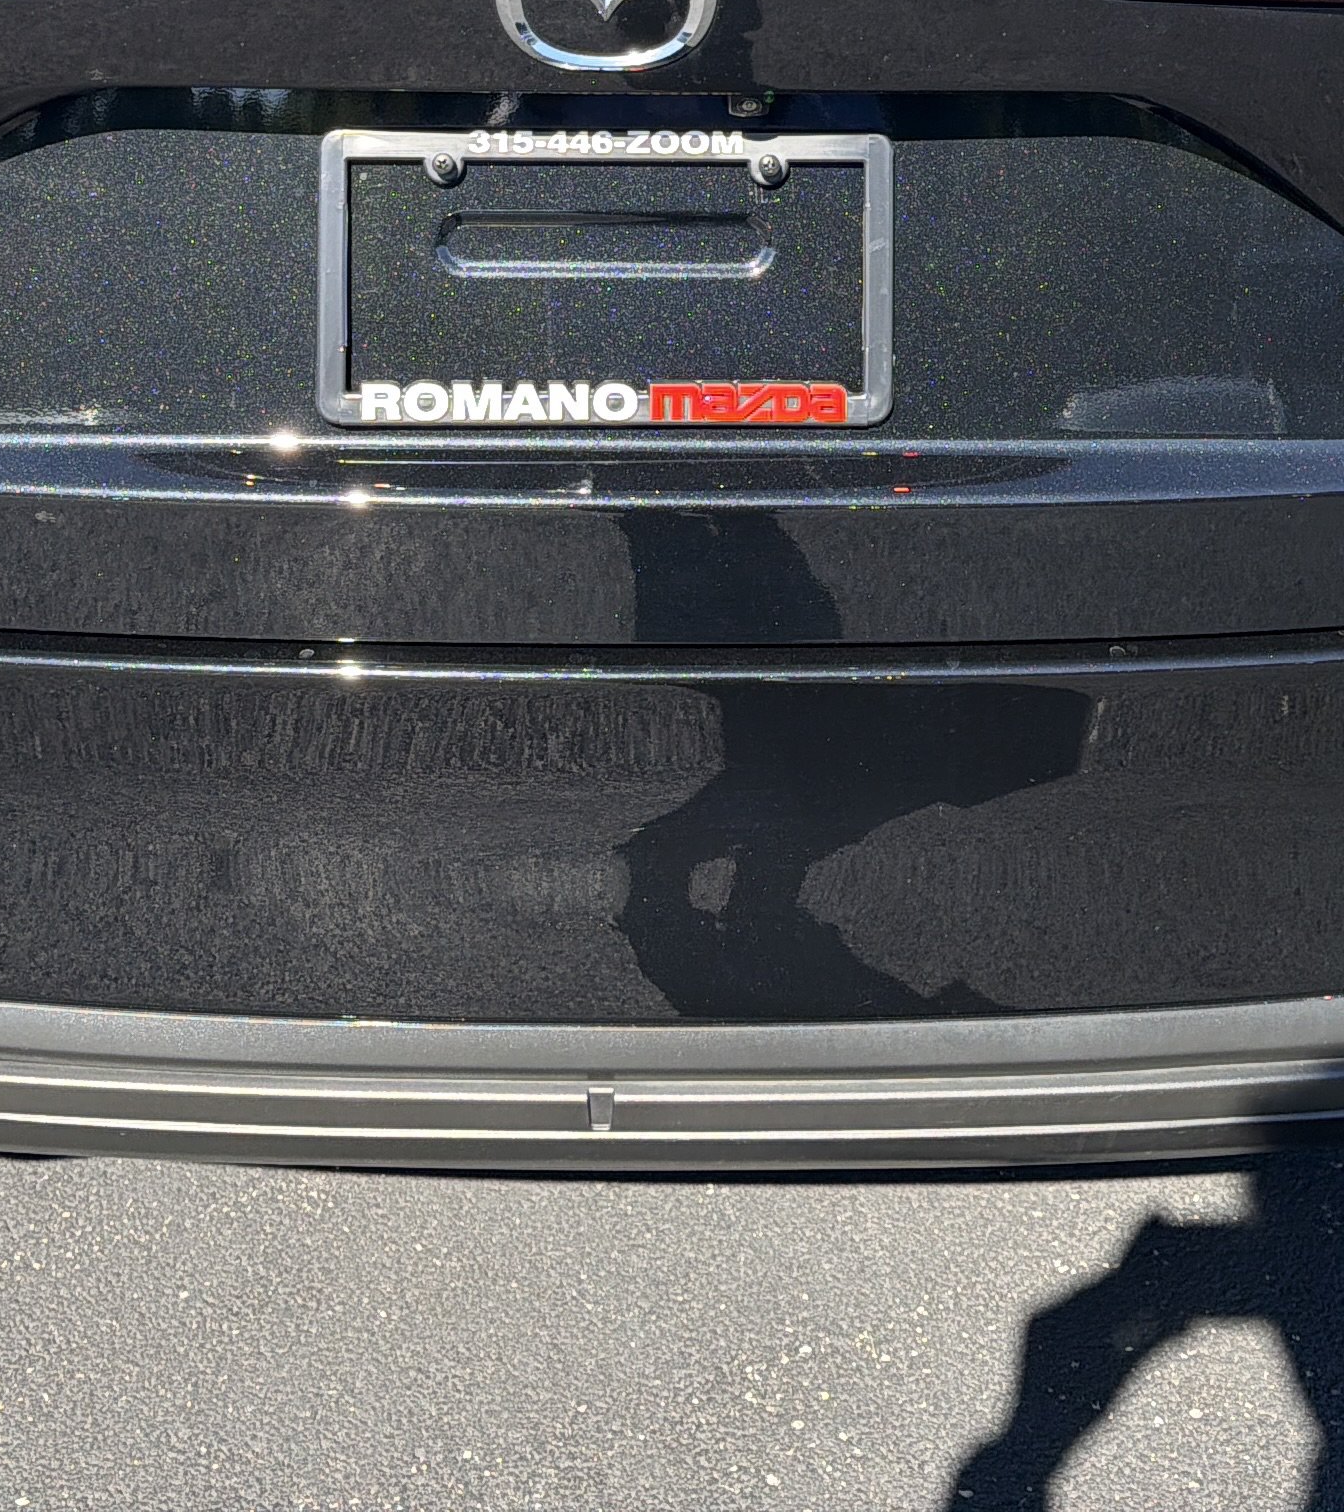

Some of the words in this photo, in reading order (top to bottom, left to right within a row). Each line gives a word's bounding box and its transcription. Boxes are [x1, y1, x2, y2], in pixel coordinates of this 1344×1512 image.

[467, 130, 745, 155] 315-446-ZOOM
[361, 383, 639, 422] ROMANO
[649, 382, 848, 423] mazda
